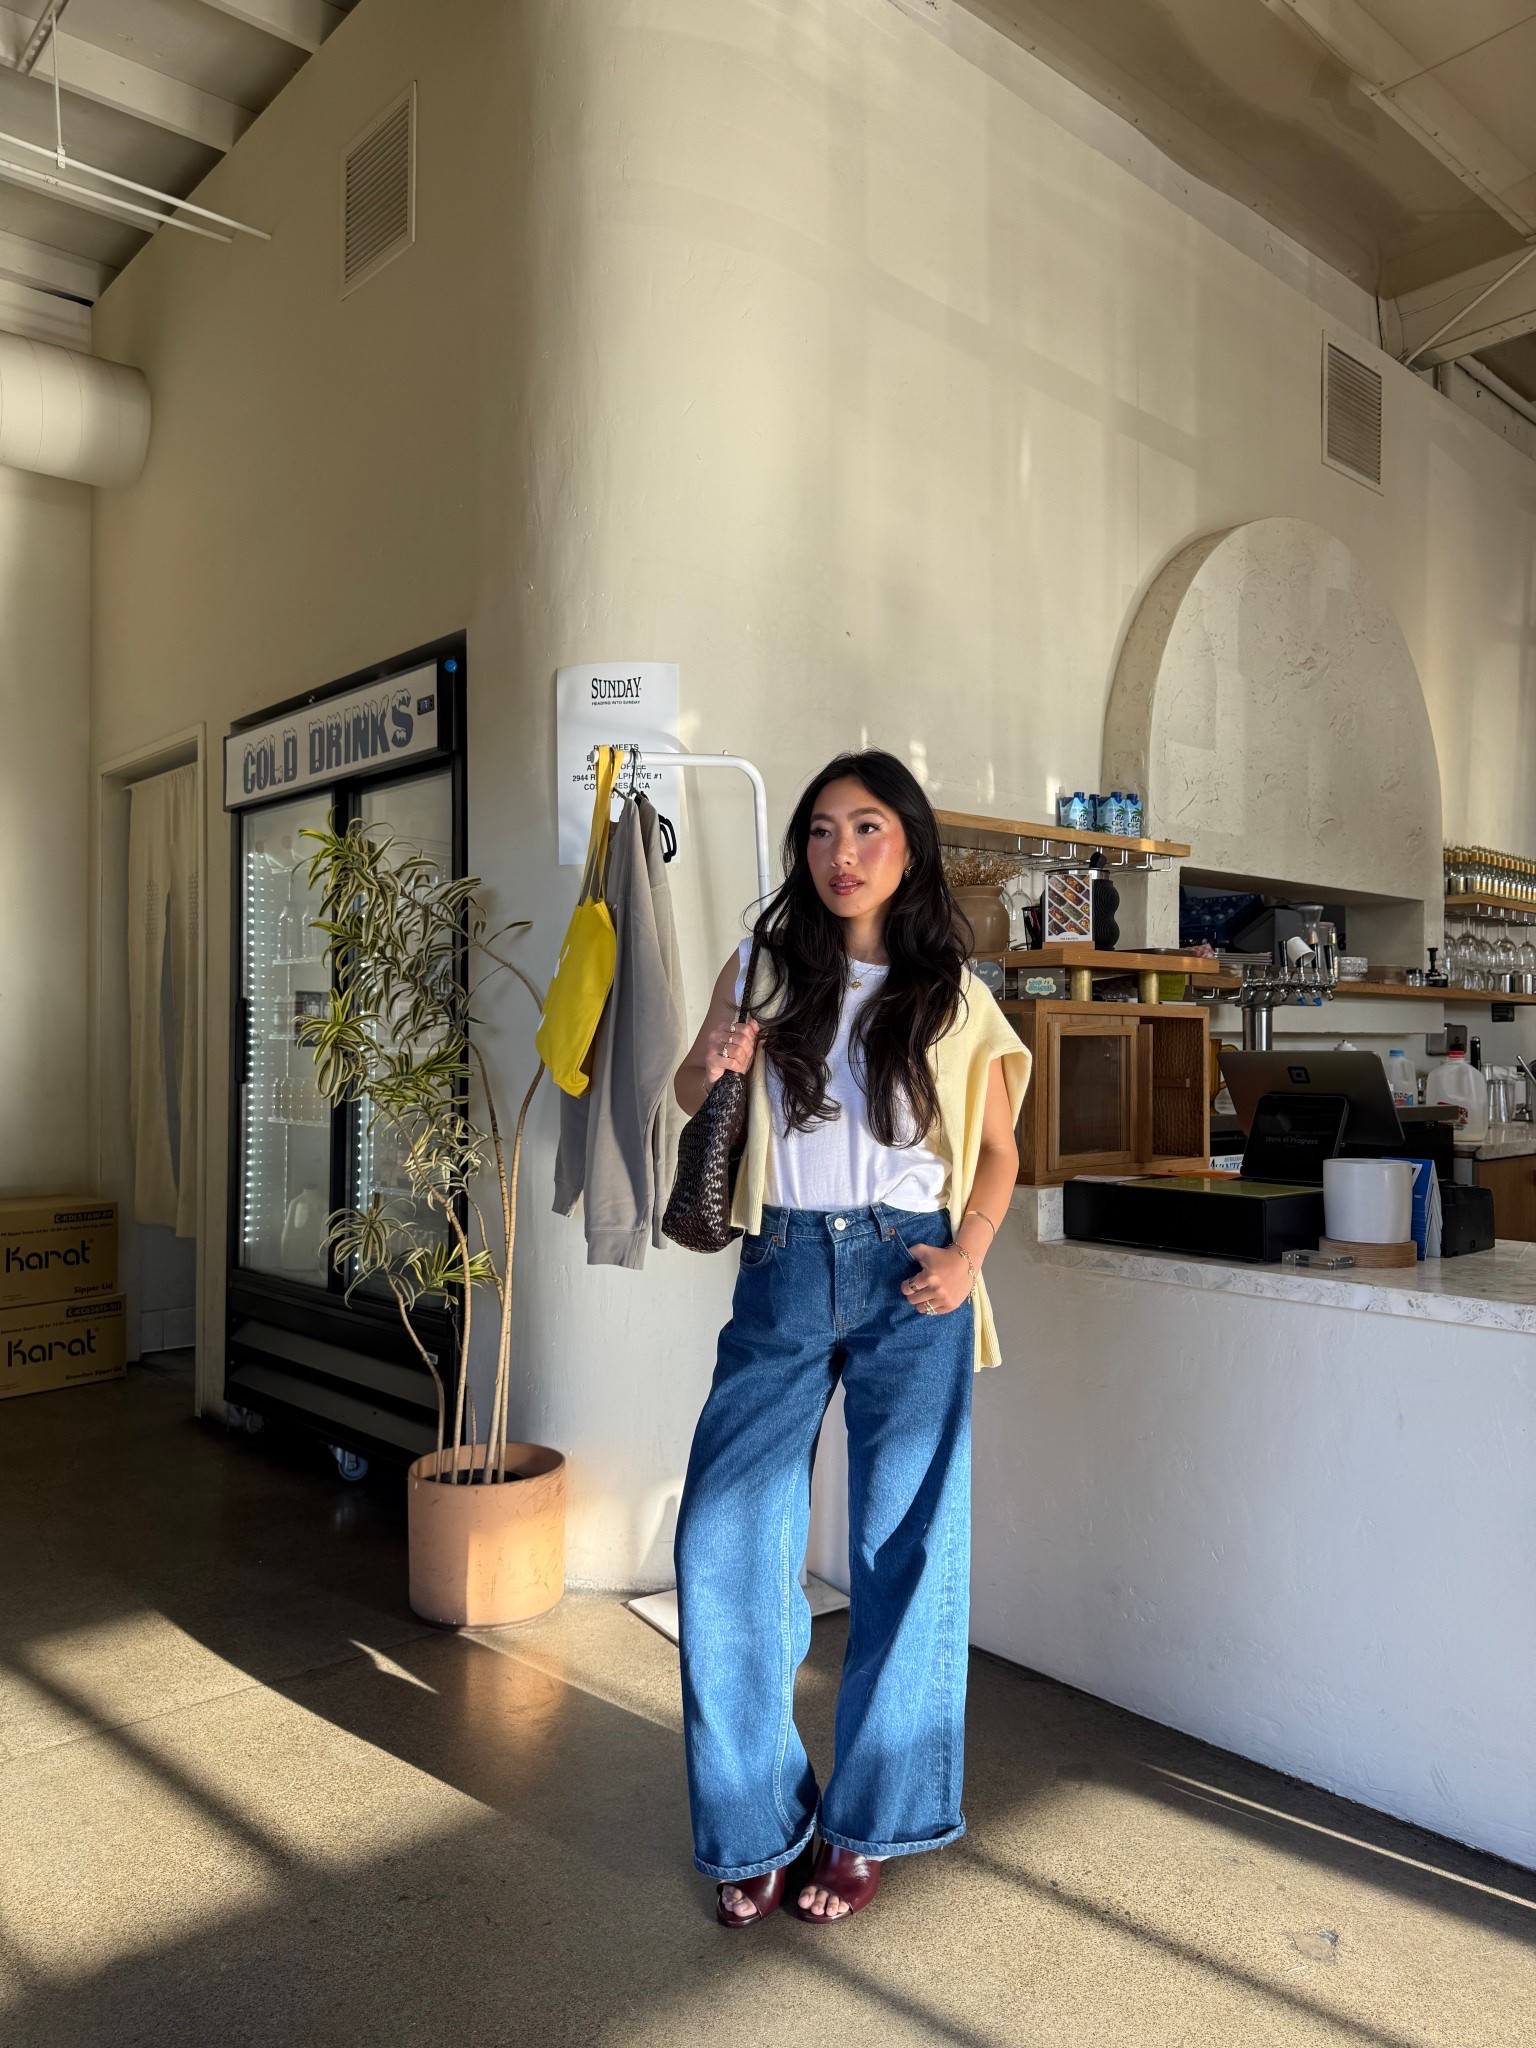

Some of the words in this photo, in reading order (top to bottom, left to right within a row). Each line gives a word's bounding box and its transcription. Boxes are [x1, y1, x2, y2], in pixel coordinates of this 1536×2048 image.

[591, 676, 642, 699] SUNDAY
[243, 727, 298, 795] COLD
[308, 687, 414, 775] DRINKS
[572, 774, 588, 782] 2944
[5, 1239, 90, 1273] Karat
[74, 1285, 99, 1295] Sipper
[102, 1281, 114, 1290] Lid
[8, 1328, 96, 1367] Karat
